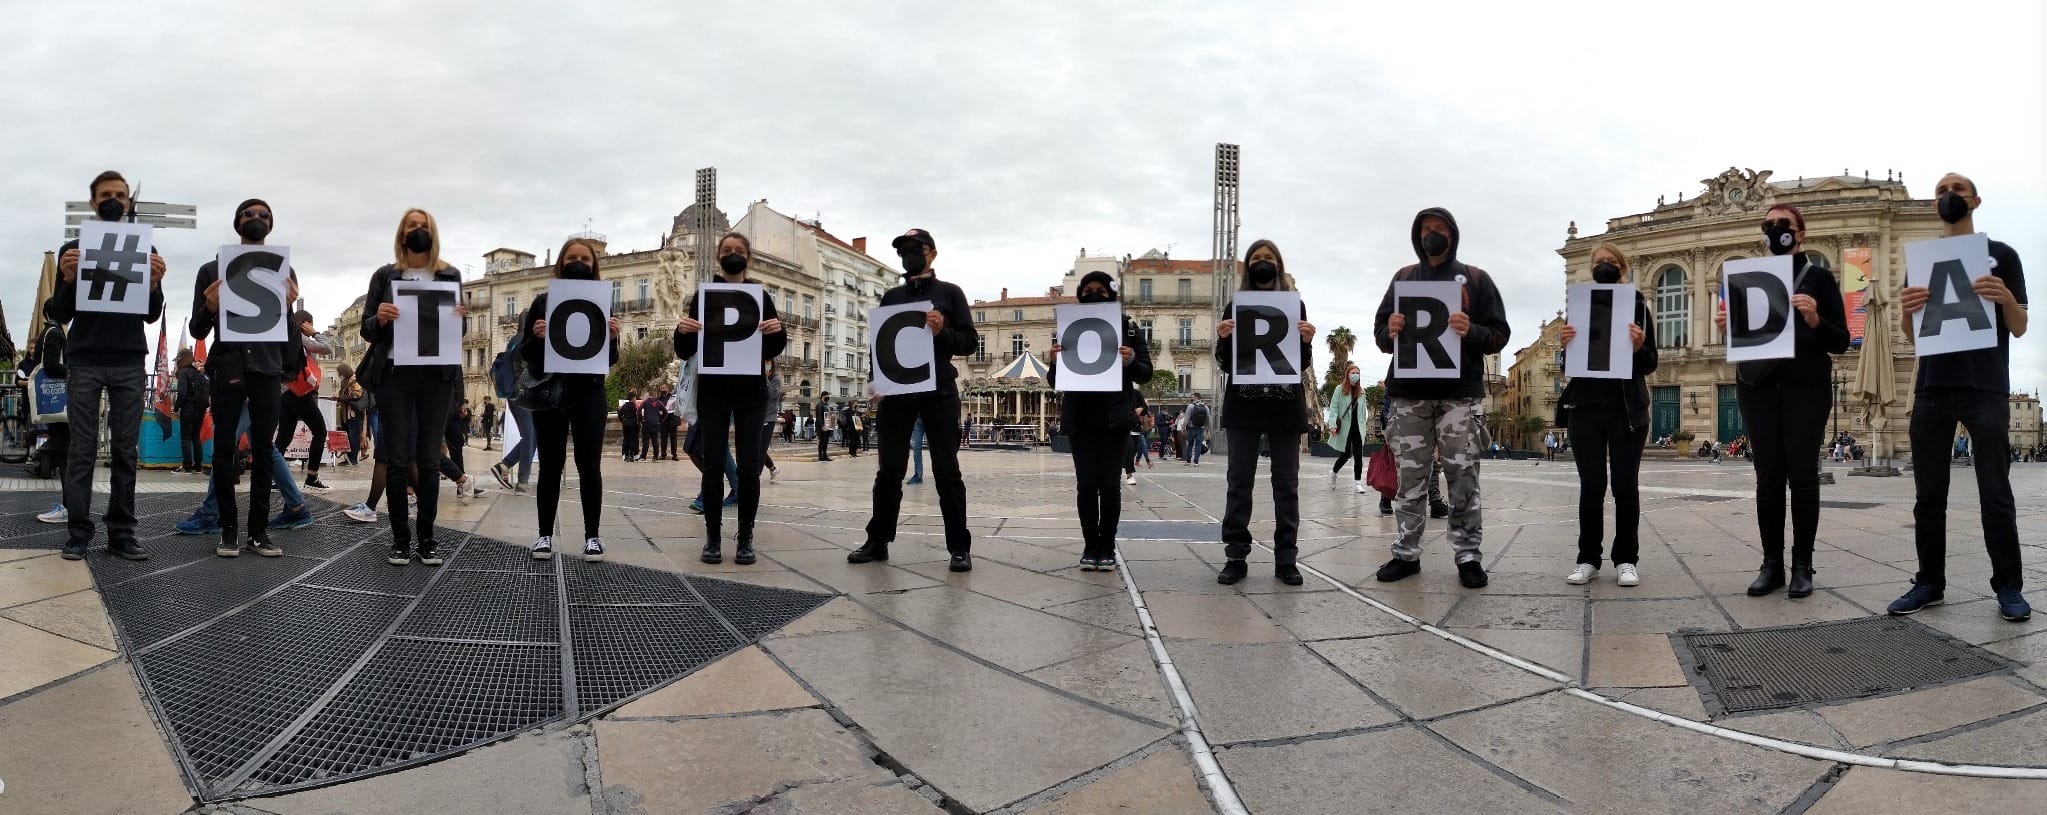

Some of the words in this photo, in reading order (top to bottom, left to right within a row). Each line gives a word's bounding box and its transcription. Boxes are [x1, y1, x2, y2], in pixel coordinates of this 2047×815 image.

[81, 233, 147, 302] #
[226, 251, 285, 334] S
[1918, 258, 1992, 338] A
[398, 289, 455, 356] T
[549, 299, 606, 360] O
[703, 290, 762, 368] P
[1236, 305, 1297, 375] R
[1397, 296, 1456, 369] R
[1587, 289, 1613, 371] I
[1728, 271, 1790, 348] D
[876, 310, 930, 384] C
[1061, 318, 1118, 375] O
